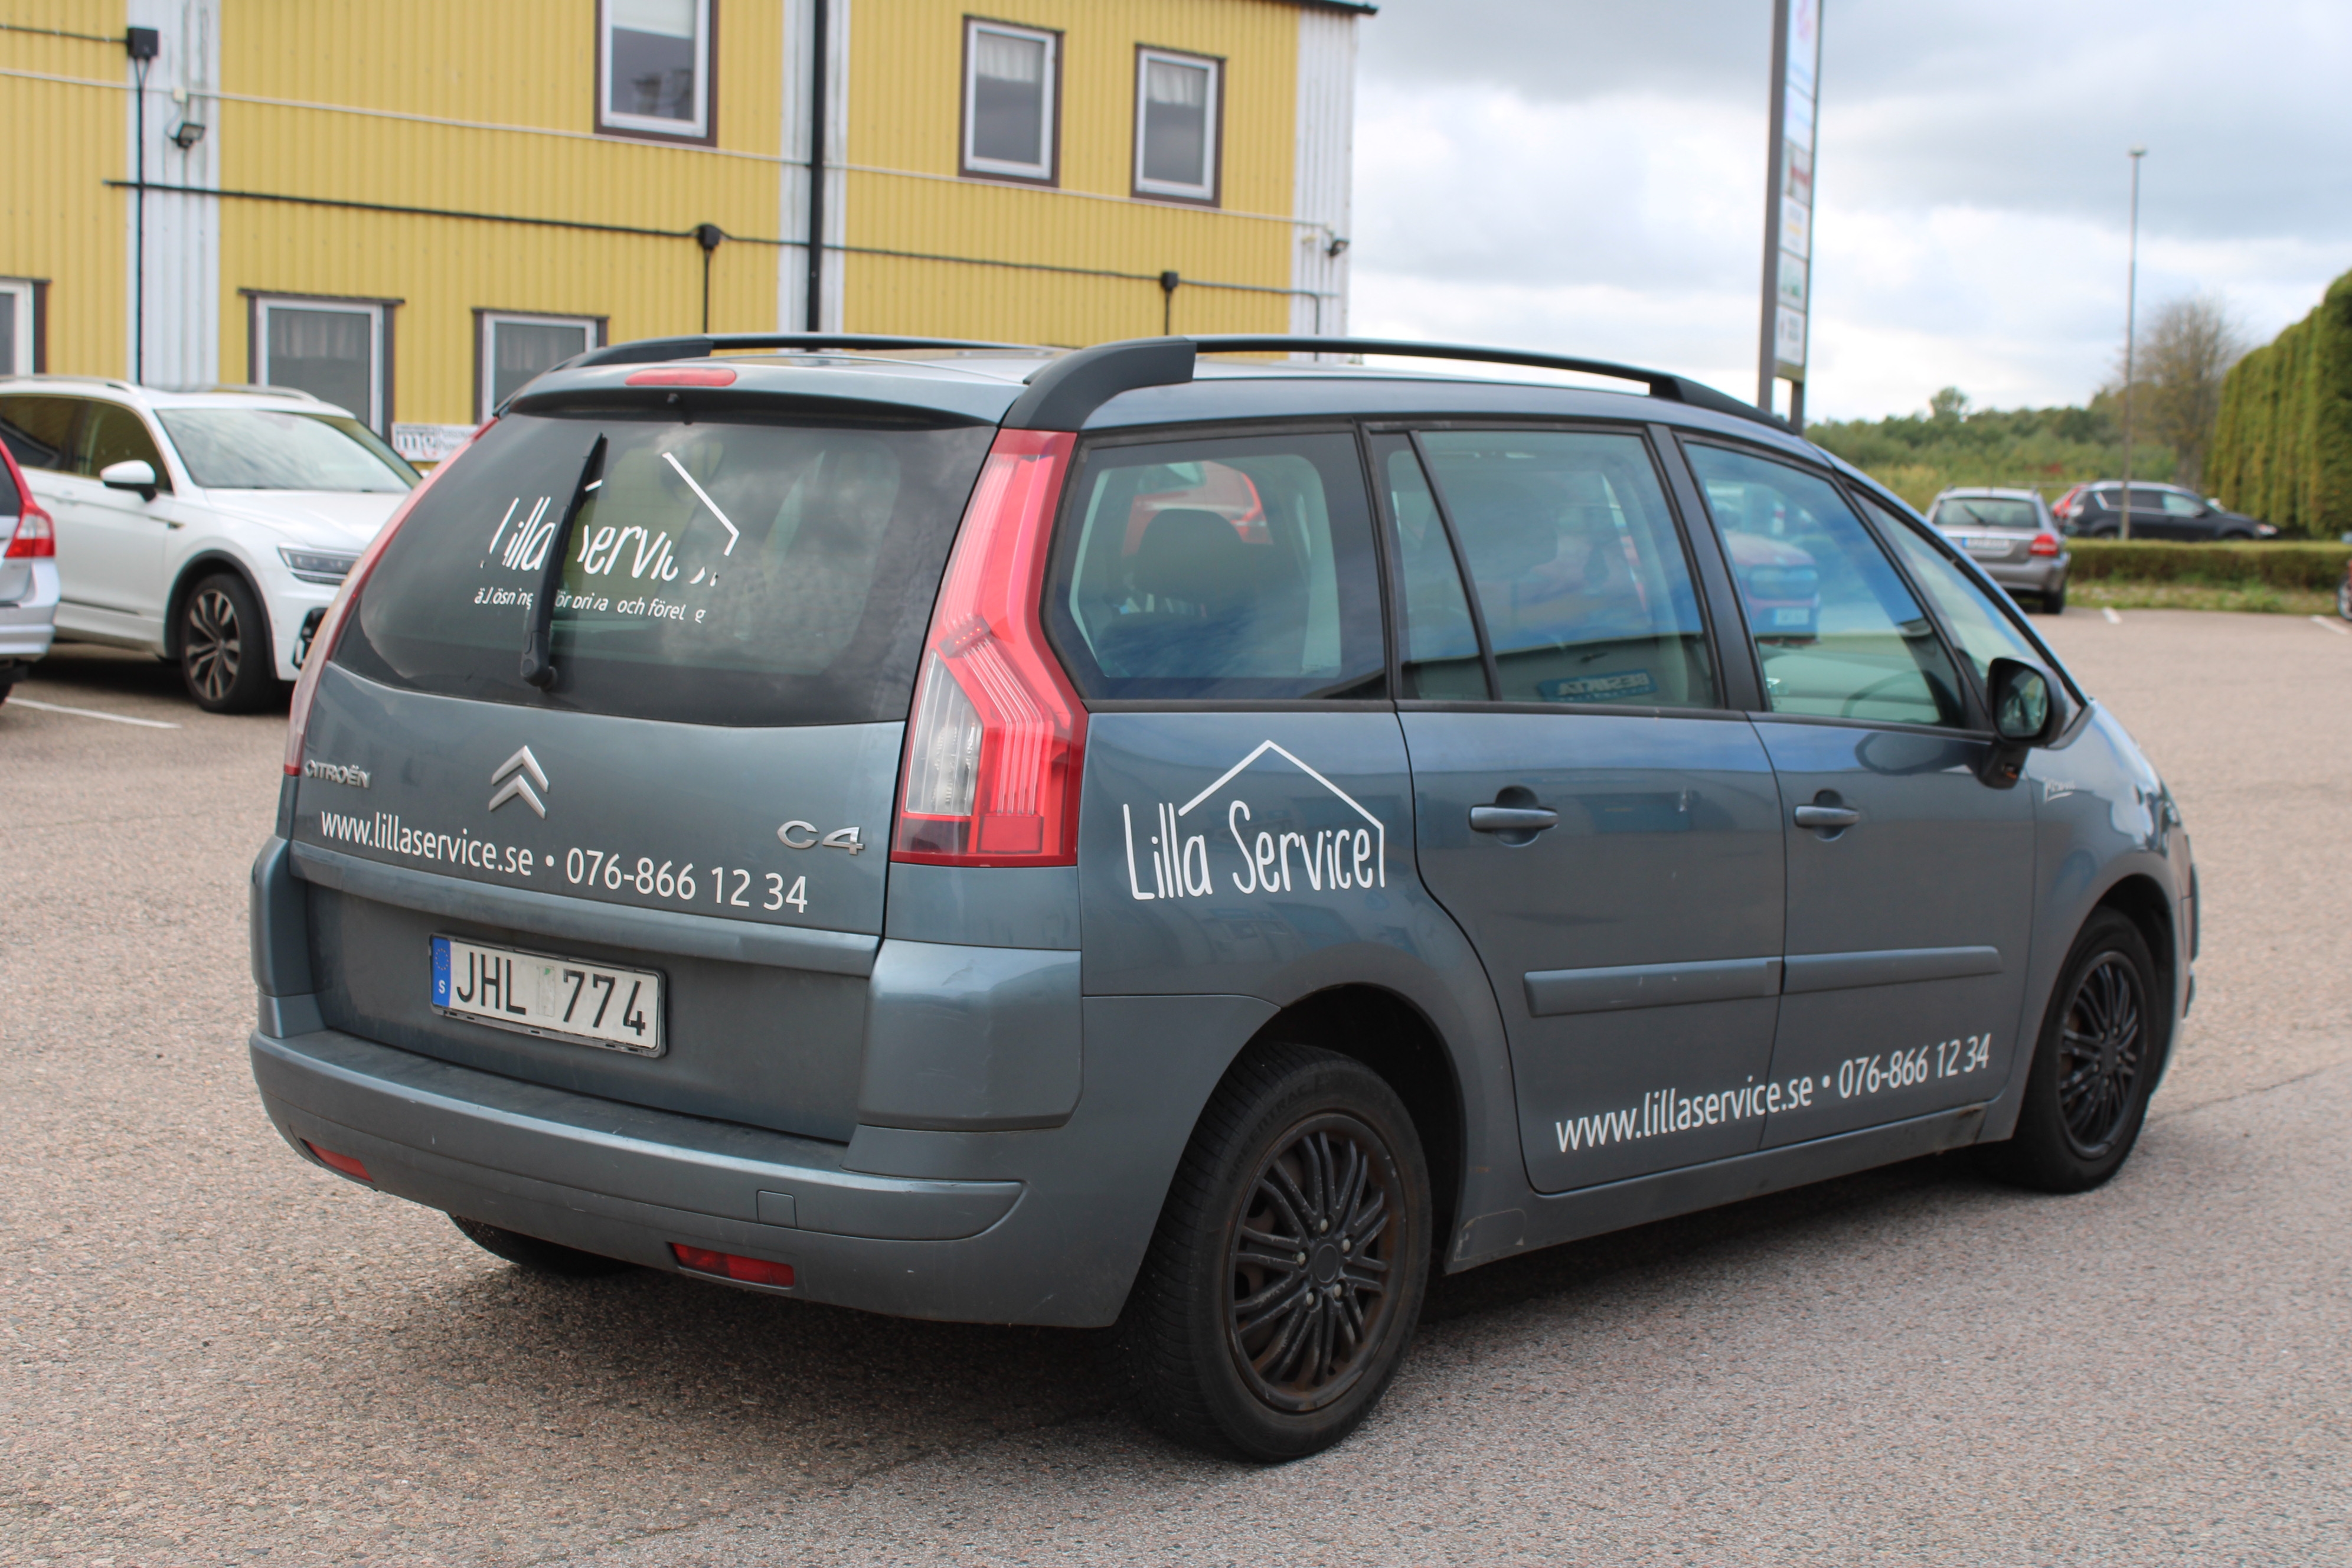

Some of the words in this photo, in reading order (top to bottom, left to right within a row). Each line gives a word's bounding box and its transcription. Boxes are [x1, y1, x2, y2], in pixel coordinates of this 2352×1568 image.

[617, 596, 645, 615] och
[304, 759, 371, 788] CITROËN
[321, 811, 534, 876] www.lillaservice.se
[566, 847, 697, 901] 076-866
[711, 866, 751, 907] 12
[763, 873, 808, 913] 34
[777, 820, 865, 855] C4
[1123, 802, 1213, 900] Lilla
[1229, 800, 1374, 894] Service
[438, 979, 446, 994] S
[456, 951, 527, 1016] JHL
[563, 968, 646, 1036] 774
[1555, 1074, 1813, 1153] www.lillaservice.se
[1838, 1046, 1929, 1099] 076-866
[1936, 1038, 1959, 1079] 12
[1964, 1032, 1992, 1072] 34
